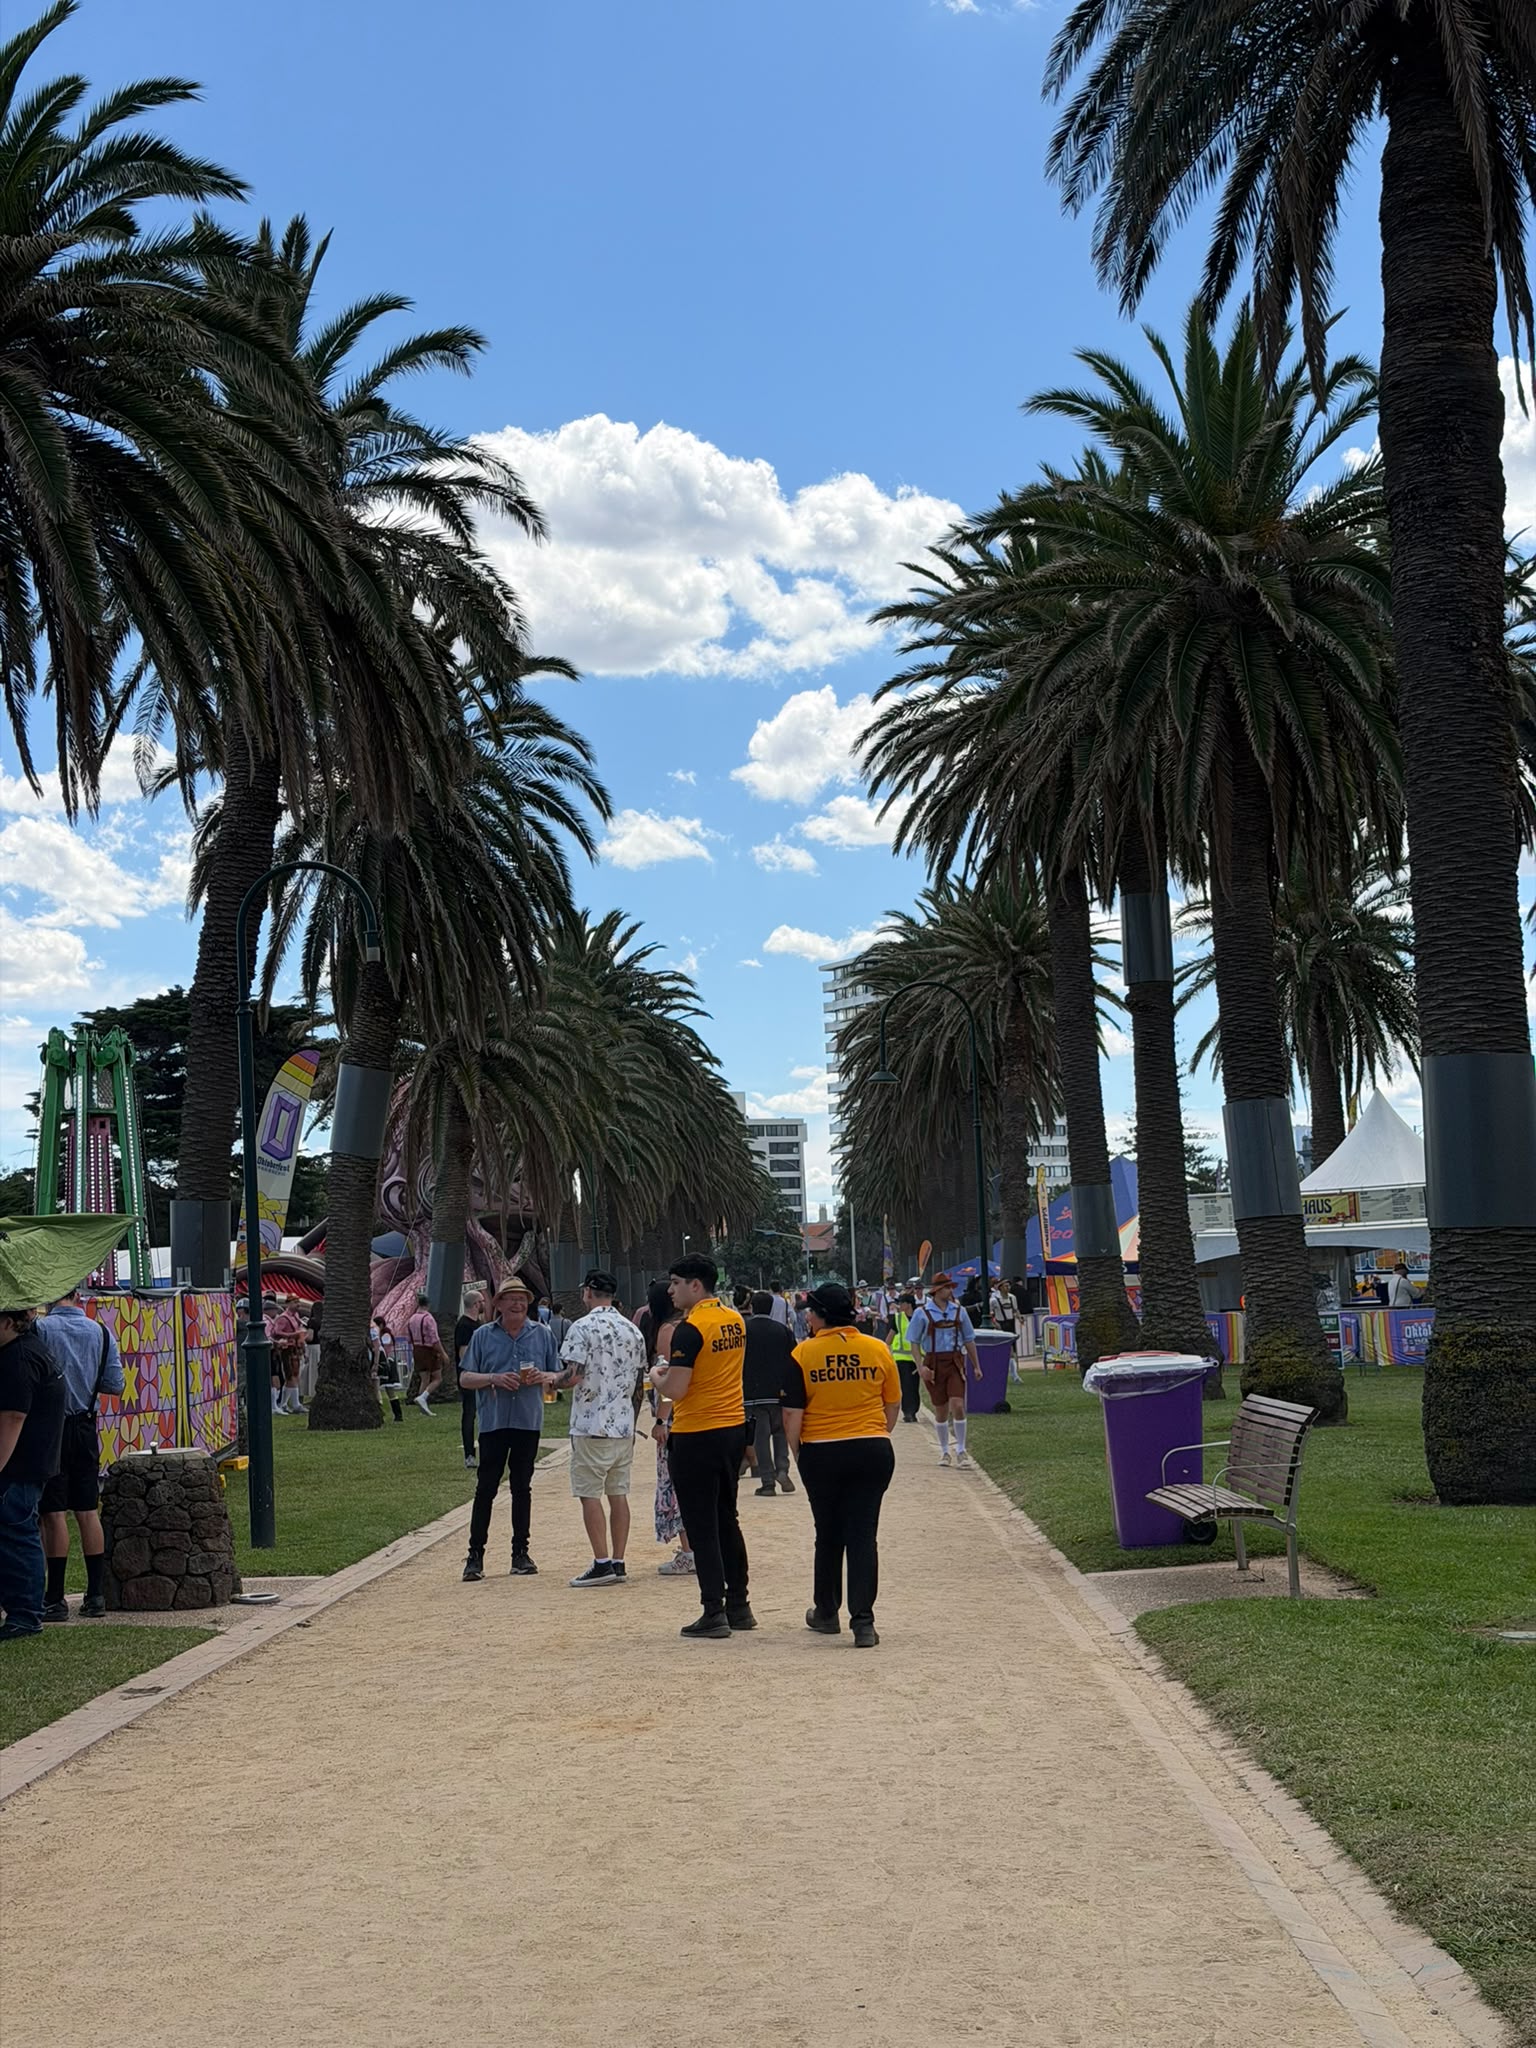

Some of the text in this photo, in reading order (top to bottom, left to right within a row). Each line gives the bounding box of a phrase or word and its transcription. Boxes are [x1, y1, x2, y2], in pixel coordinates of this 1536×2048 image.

[257, 1156, 290, 1172] Oktoberfest
[721, 1323, 742, 1337] FRS
[825, 1354, 860, 1367] FRS
[810, 1367, 877, 1383] SECURITY
